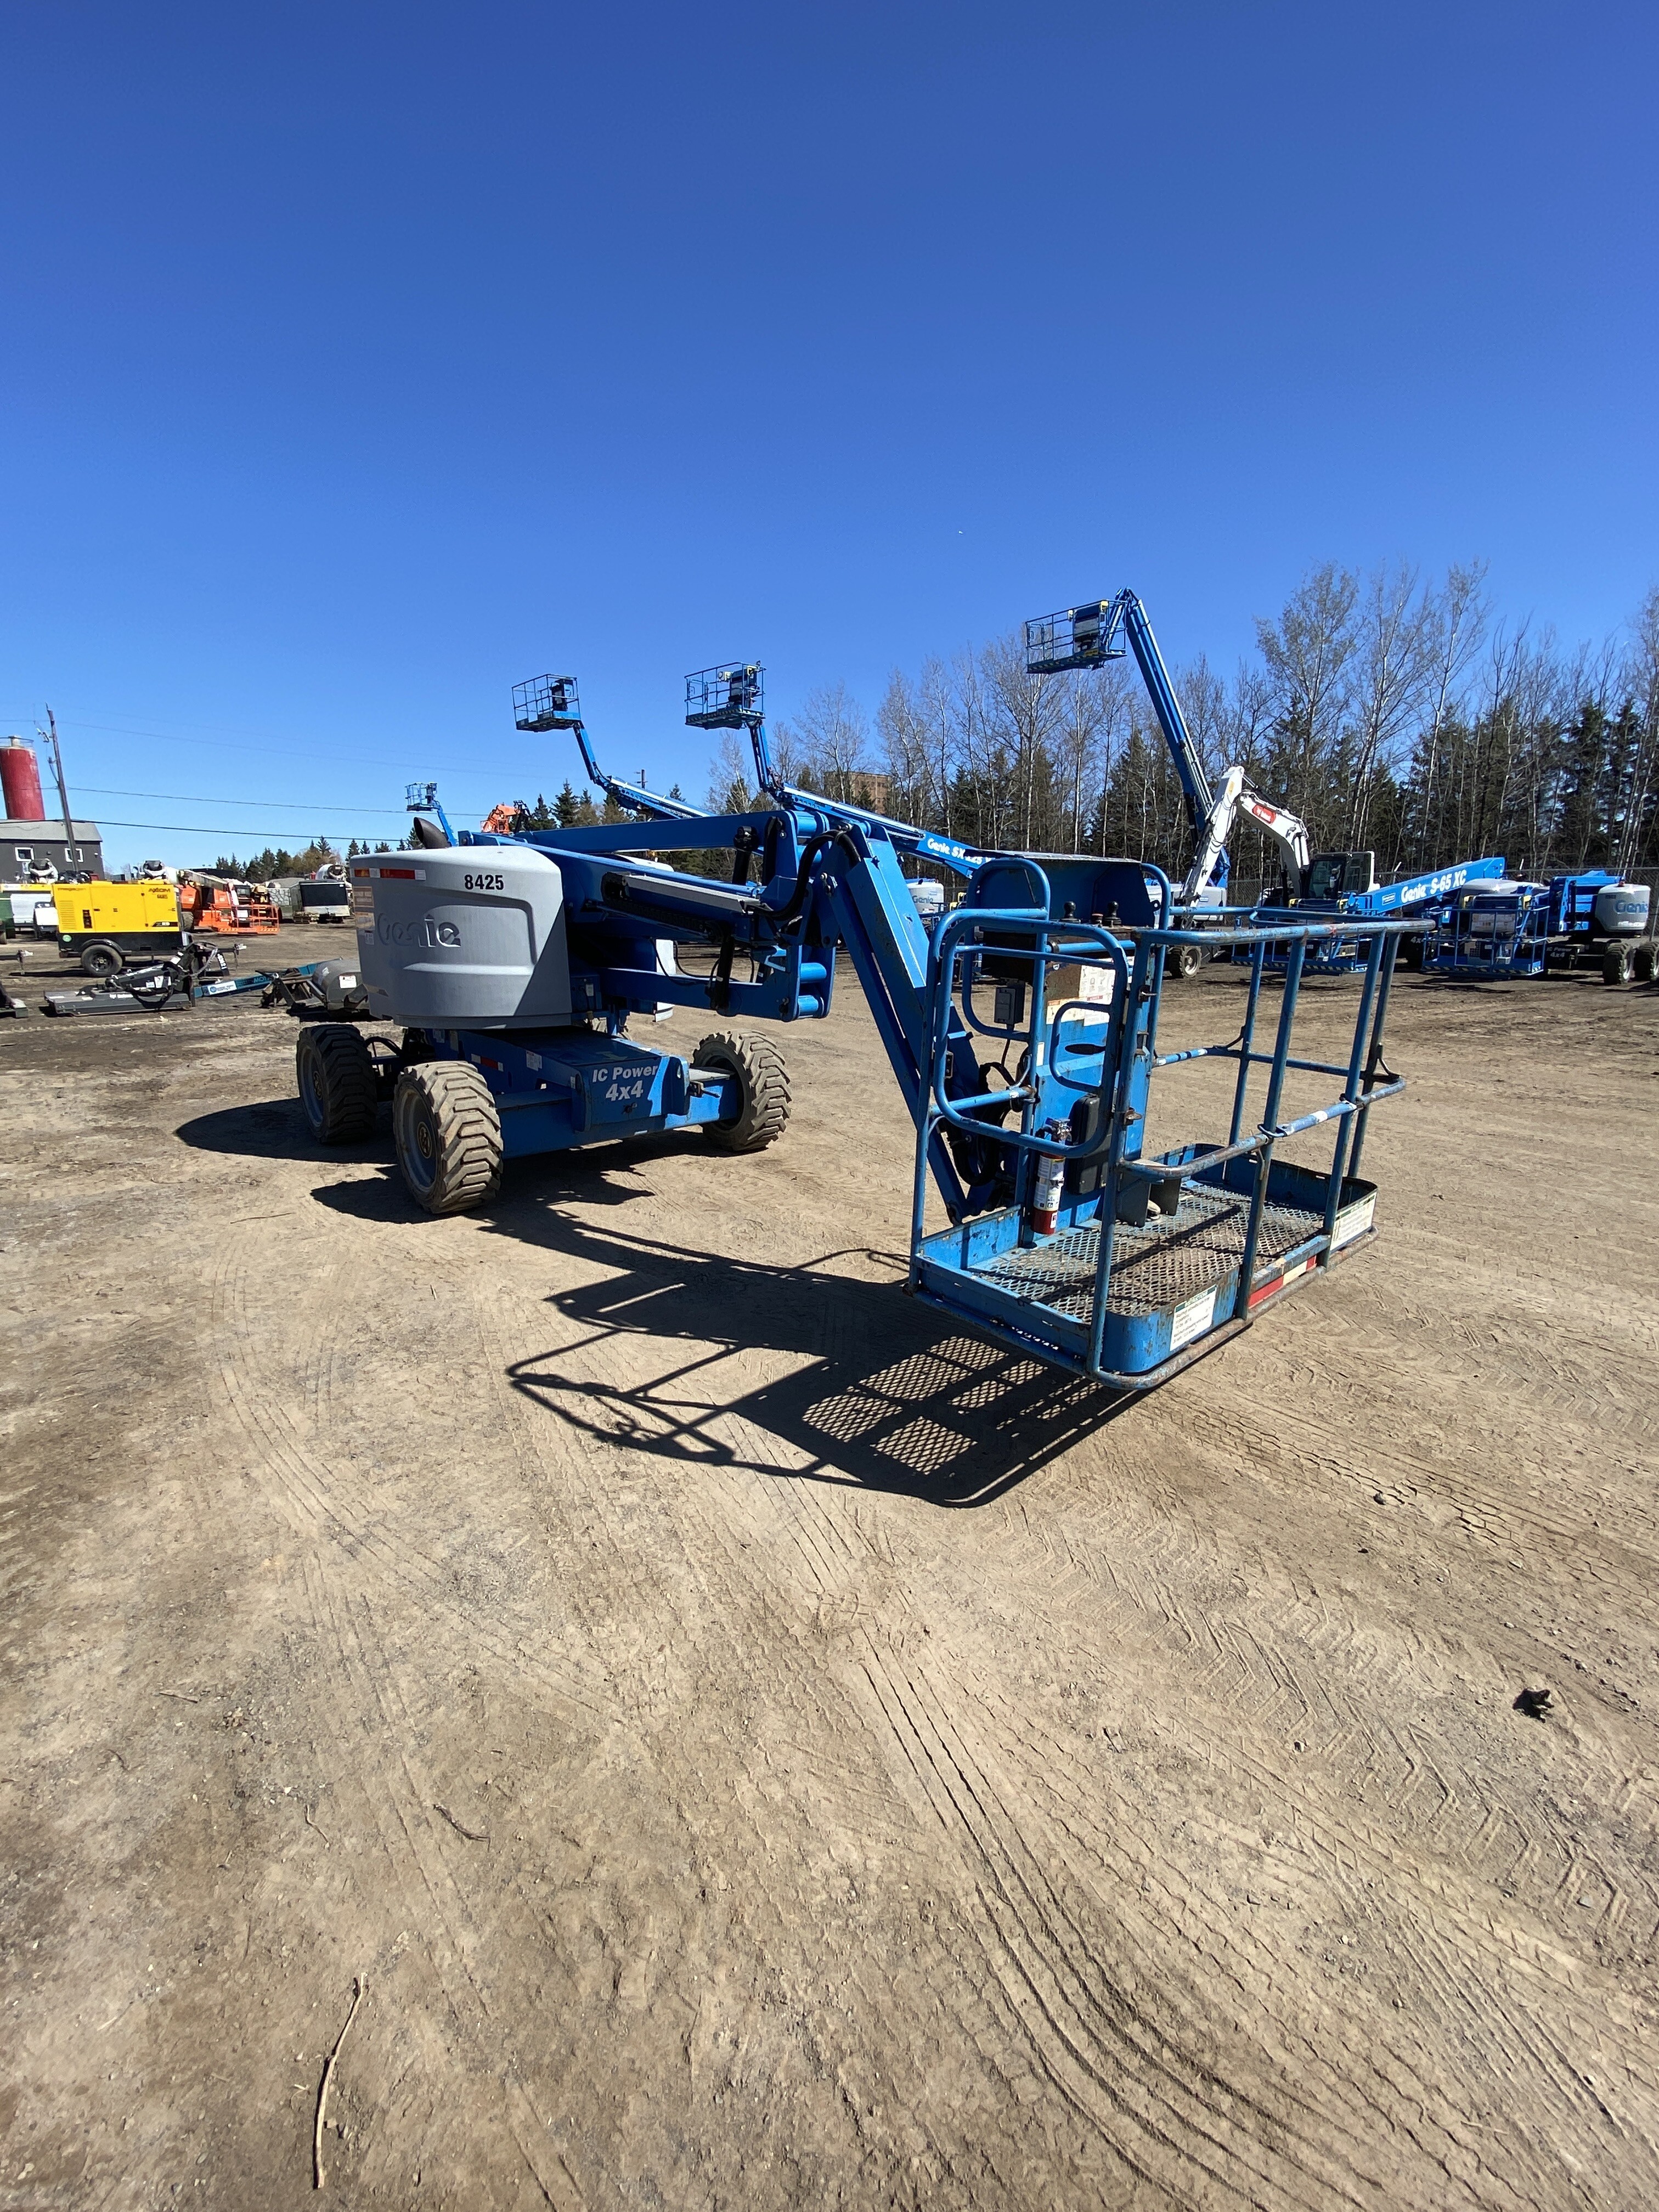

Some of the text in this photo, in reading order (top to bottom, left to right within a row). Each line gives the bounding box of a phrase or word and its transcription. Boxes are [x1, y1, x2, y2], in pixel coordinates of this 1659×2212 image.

[927, 838, 950, 854] Genie
[464, 874, 504, 890] 8425
[1401, 883, 1426, 904] Genie
[1430, 873, 1453, 894] S-65
[1453, 869, 1467, 888] XC
[377, 912, 461, 947] Genie
[592, 1065, 658, 1082] IC Power
[606, 1080, 644, 1101] 4x4
